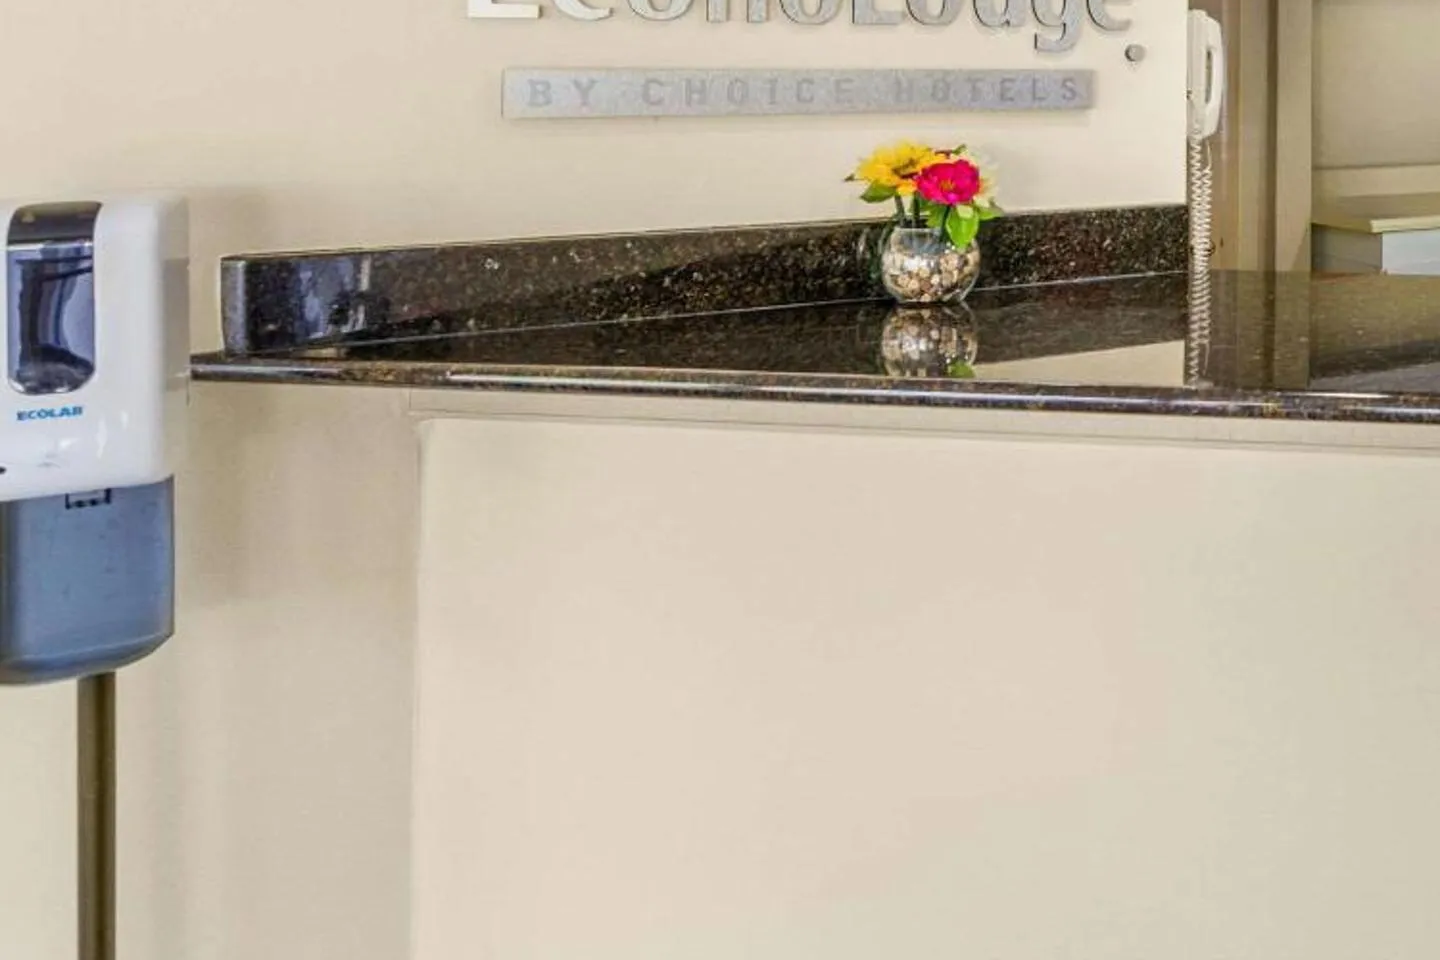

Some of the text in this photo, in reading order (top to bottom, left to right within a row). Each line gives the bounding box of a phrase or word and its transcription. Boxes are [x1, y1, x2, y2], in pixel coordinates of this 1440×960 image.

[527, 77, 1079, 108] BY CHOICE HOTELS
[17, 405, 83, 421] ECOLAB
